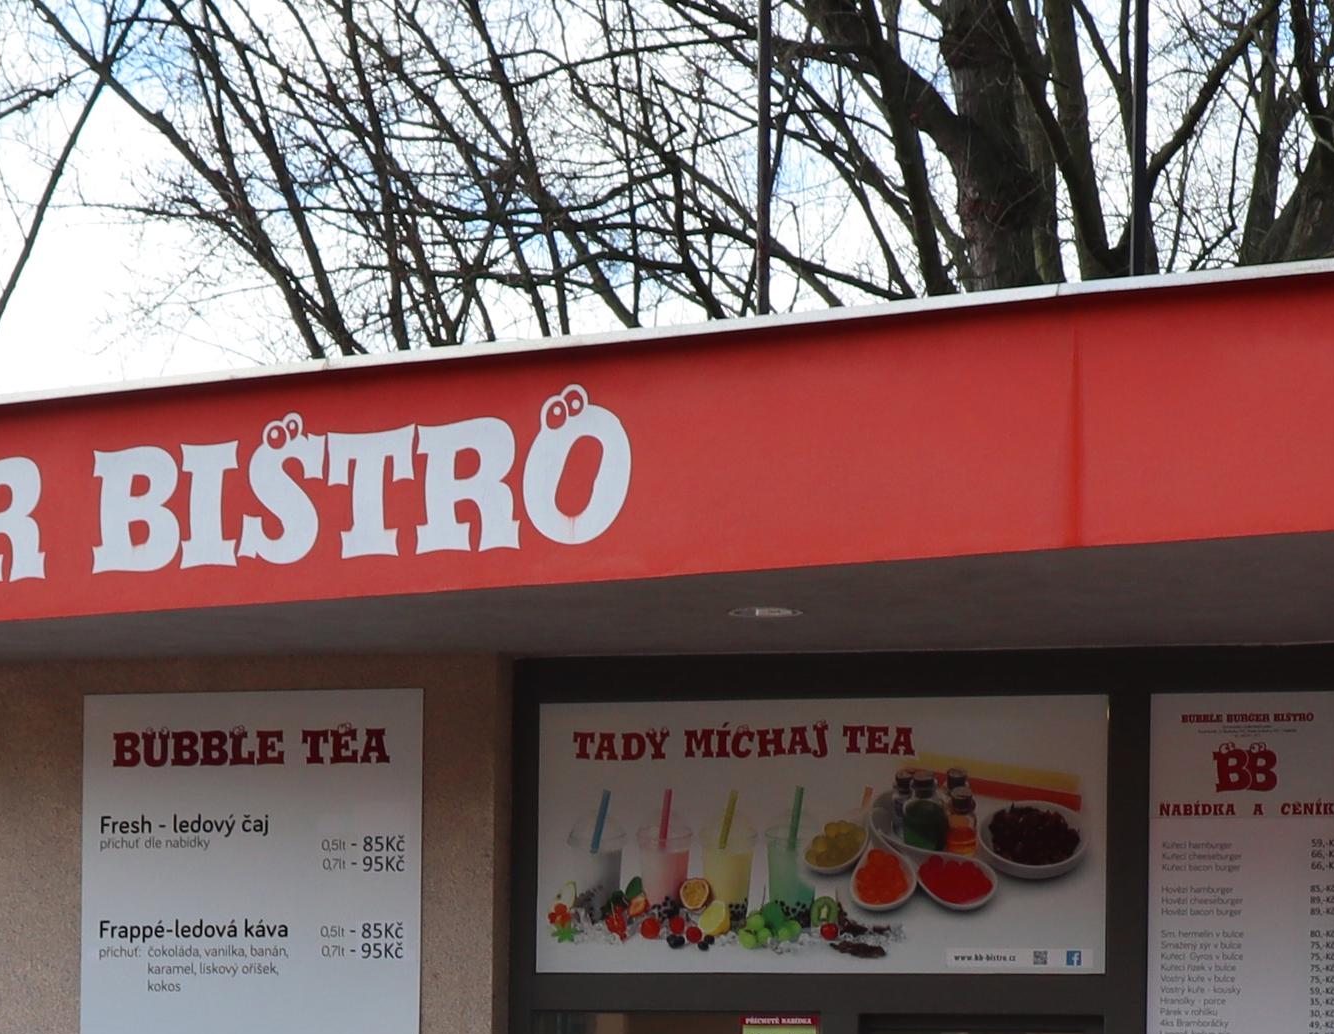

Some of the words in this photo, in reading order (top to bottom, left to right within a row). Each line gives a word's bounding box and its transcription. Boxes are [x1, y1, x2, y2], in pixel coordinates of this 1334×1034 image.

[91, 384, 631, 573] BISTRO
[1181, 713, 1223, 724] BUBBLE
[1226, 713, 1269, 723] BURGER
[1273, 712, 1314, 722] BISTRO
[113, 725, 284, 767] BUBBLE
[301, 721, 390, 765] TEA
[573, 726, 670, 760] TADY
[684, 720, 830, 759] MÍCHAJ
[842, 724, 915, 757] TEA
[1212, 741, 1278, 793] BB
[1159, 801, 1236, 816] NABÍDKA
[1253, 803, 1264, 816] A
[1280, 798, 1334, 816] CENÍK
[100, 815, 152, 834] Fresh
[173, 815, 235, 837] ledový
[242, 815, 269, 836] čaj
[144, 836, 162, 848] dle
[165, 836, 210, 851] nabídky
[362, 835, 405, 852] 85Kč
[362, 855, 405, 872] 95Kč
[99, 919, 238, 942] Frappé-ledová
[244, 919, 289, 938] káva
[361, 922, 403, 939] 85Kč
[147, 945, 202, 960] čokoláda,
[203, 945, 248, 960] vanilka,
[250, 945, 289, 959] banán,
[361, 942, 403, 959] 95Kč
[147, 963, 196, 976] karamel,
[147, 980, 181, 992] kokos
